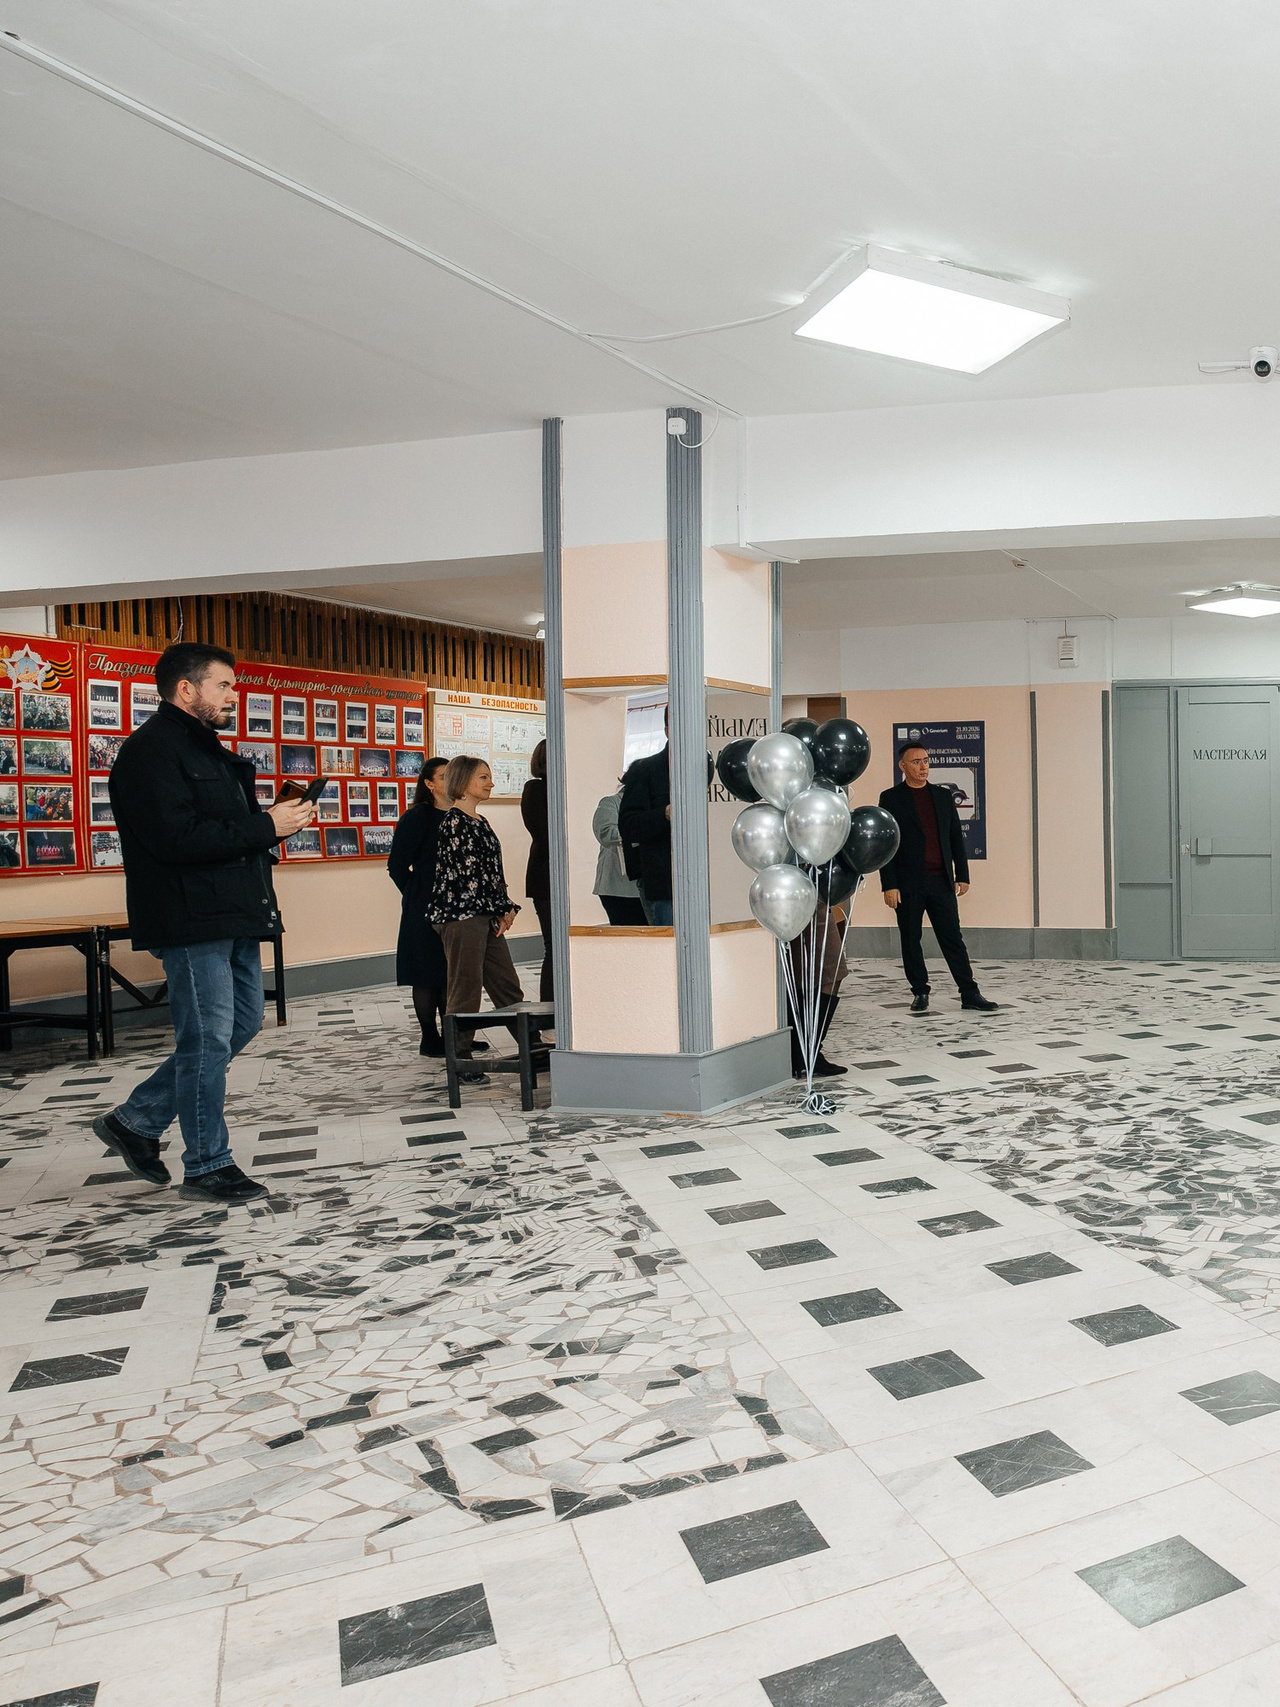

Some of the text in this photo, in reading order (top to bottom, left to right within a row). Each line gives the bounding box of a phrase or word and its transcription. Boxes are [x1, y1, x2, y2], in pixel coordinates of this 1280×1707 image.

[88, 652, 156, 679] Праздни
[235, 669, 264, 686] ского
[447, 694, 539, 712] НАША БЕЗОПАСНОСТЬ
[1192, 749, 1267, 760] МАСТЕРСКАЯ
